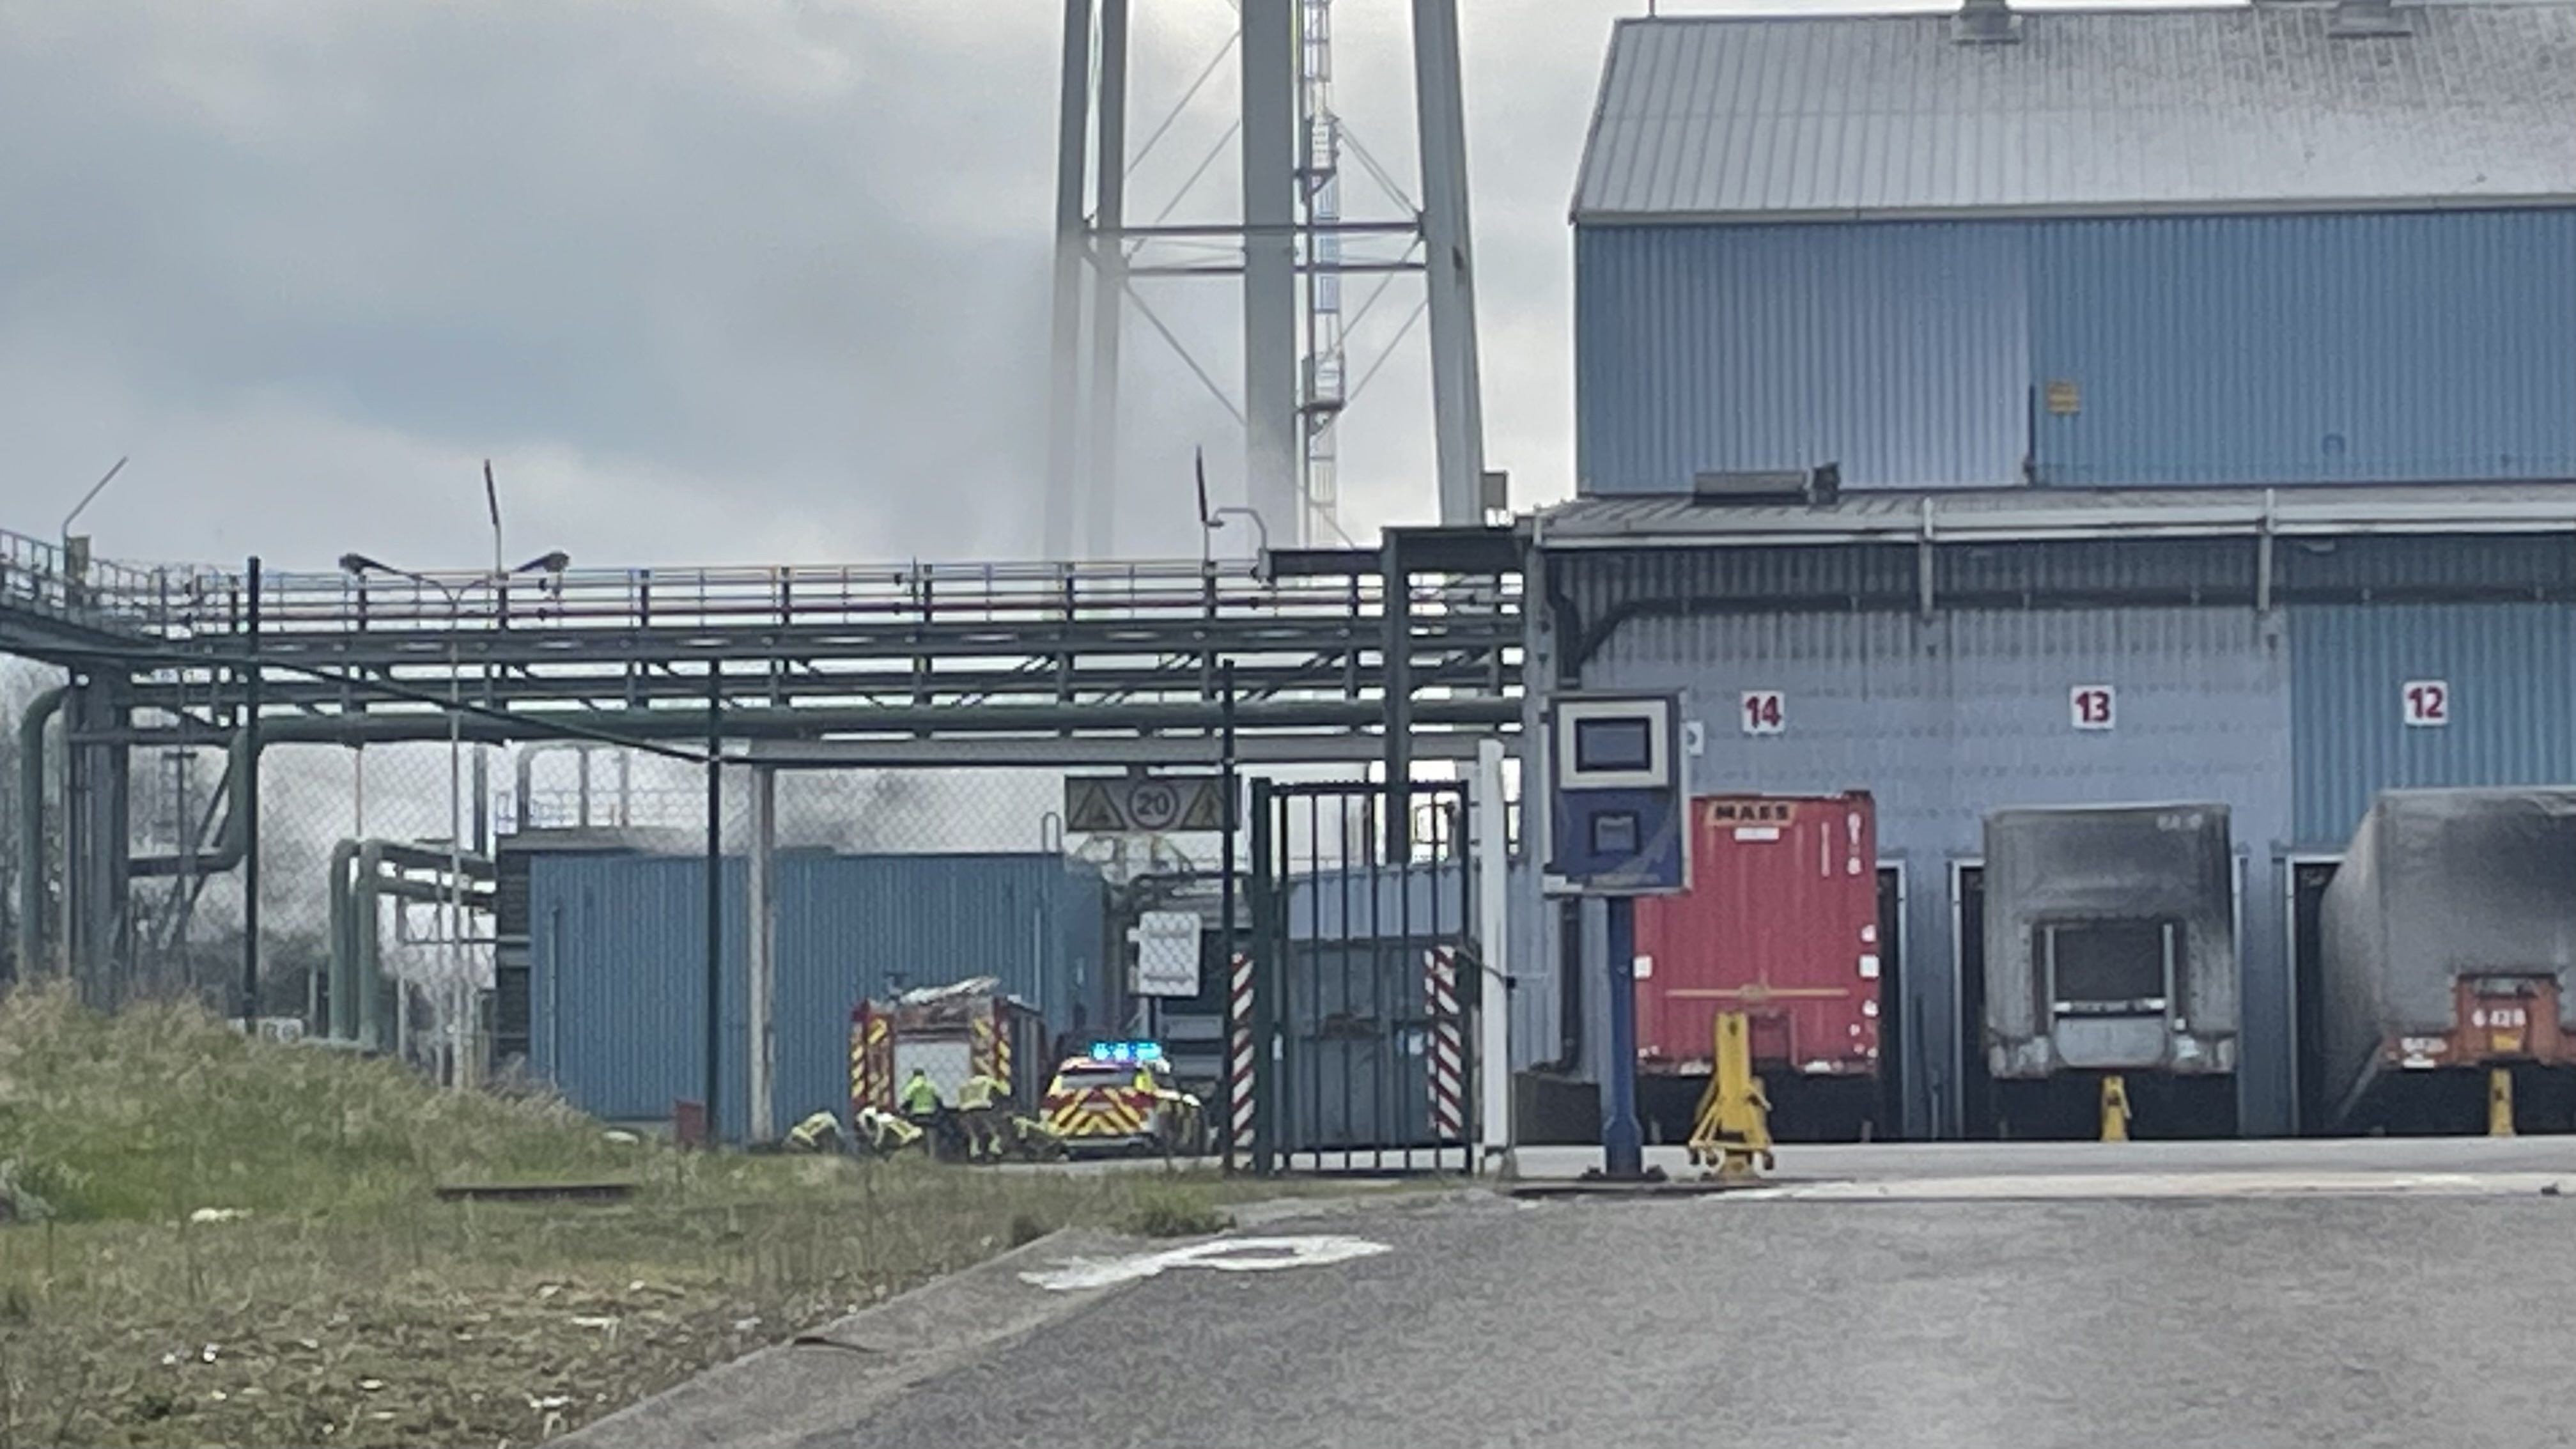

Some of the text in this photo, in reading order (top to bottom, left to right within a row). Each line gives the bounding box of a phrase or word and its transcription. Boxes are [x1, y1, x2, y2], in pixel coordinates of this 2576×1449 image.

[1746, 695, 1781, 729] 14
[2076, 691, 2111, 722] 13
[2408, 687, 2444, 718] 12
[1137, 793, 1170, 815] 20
